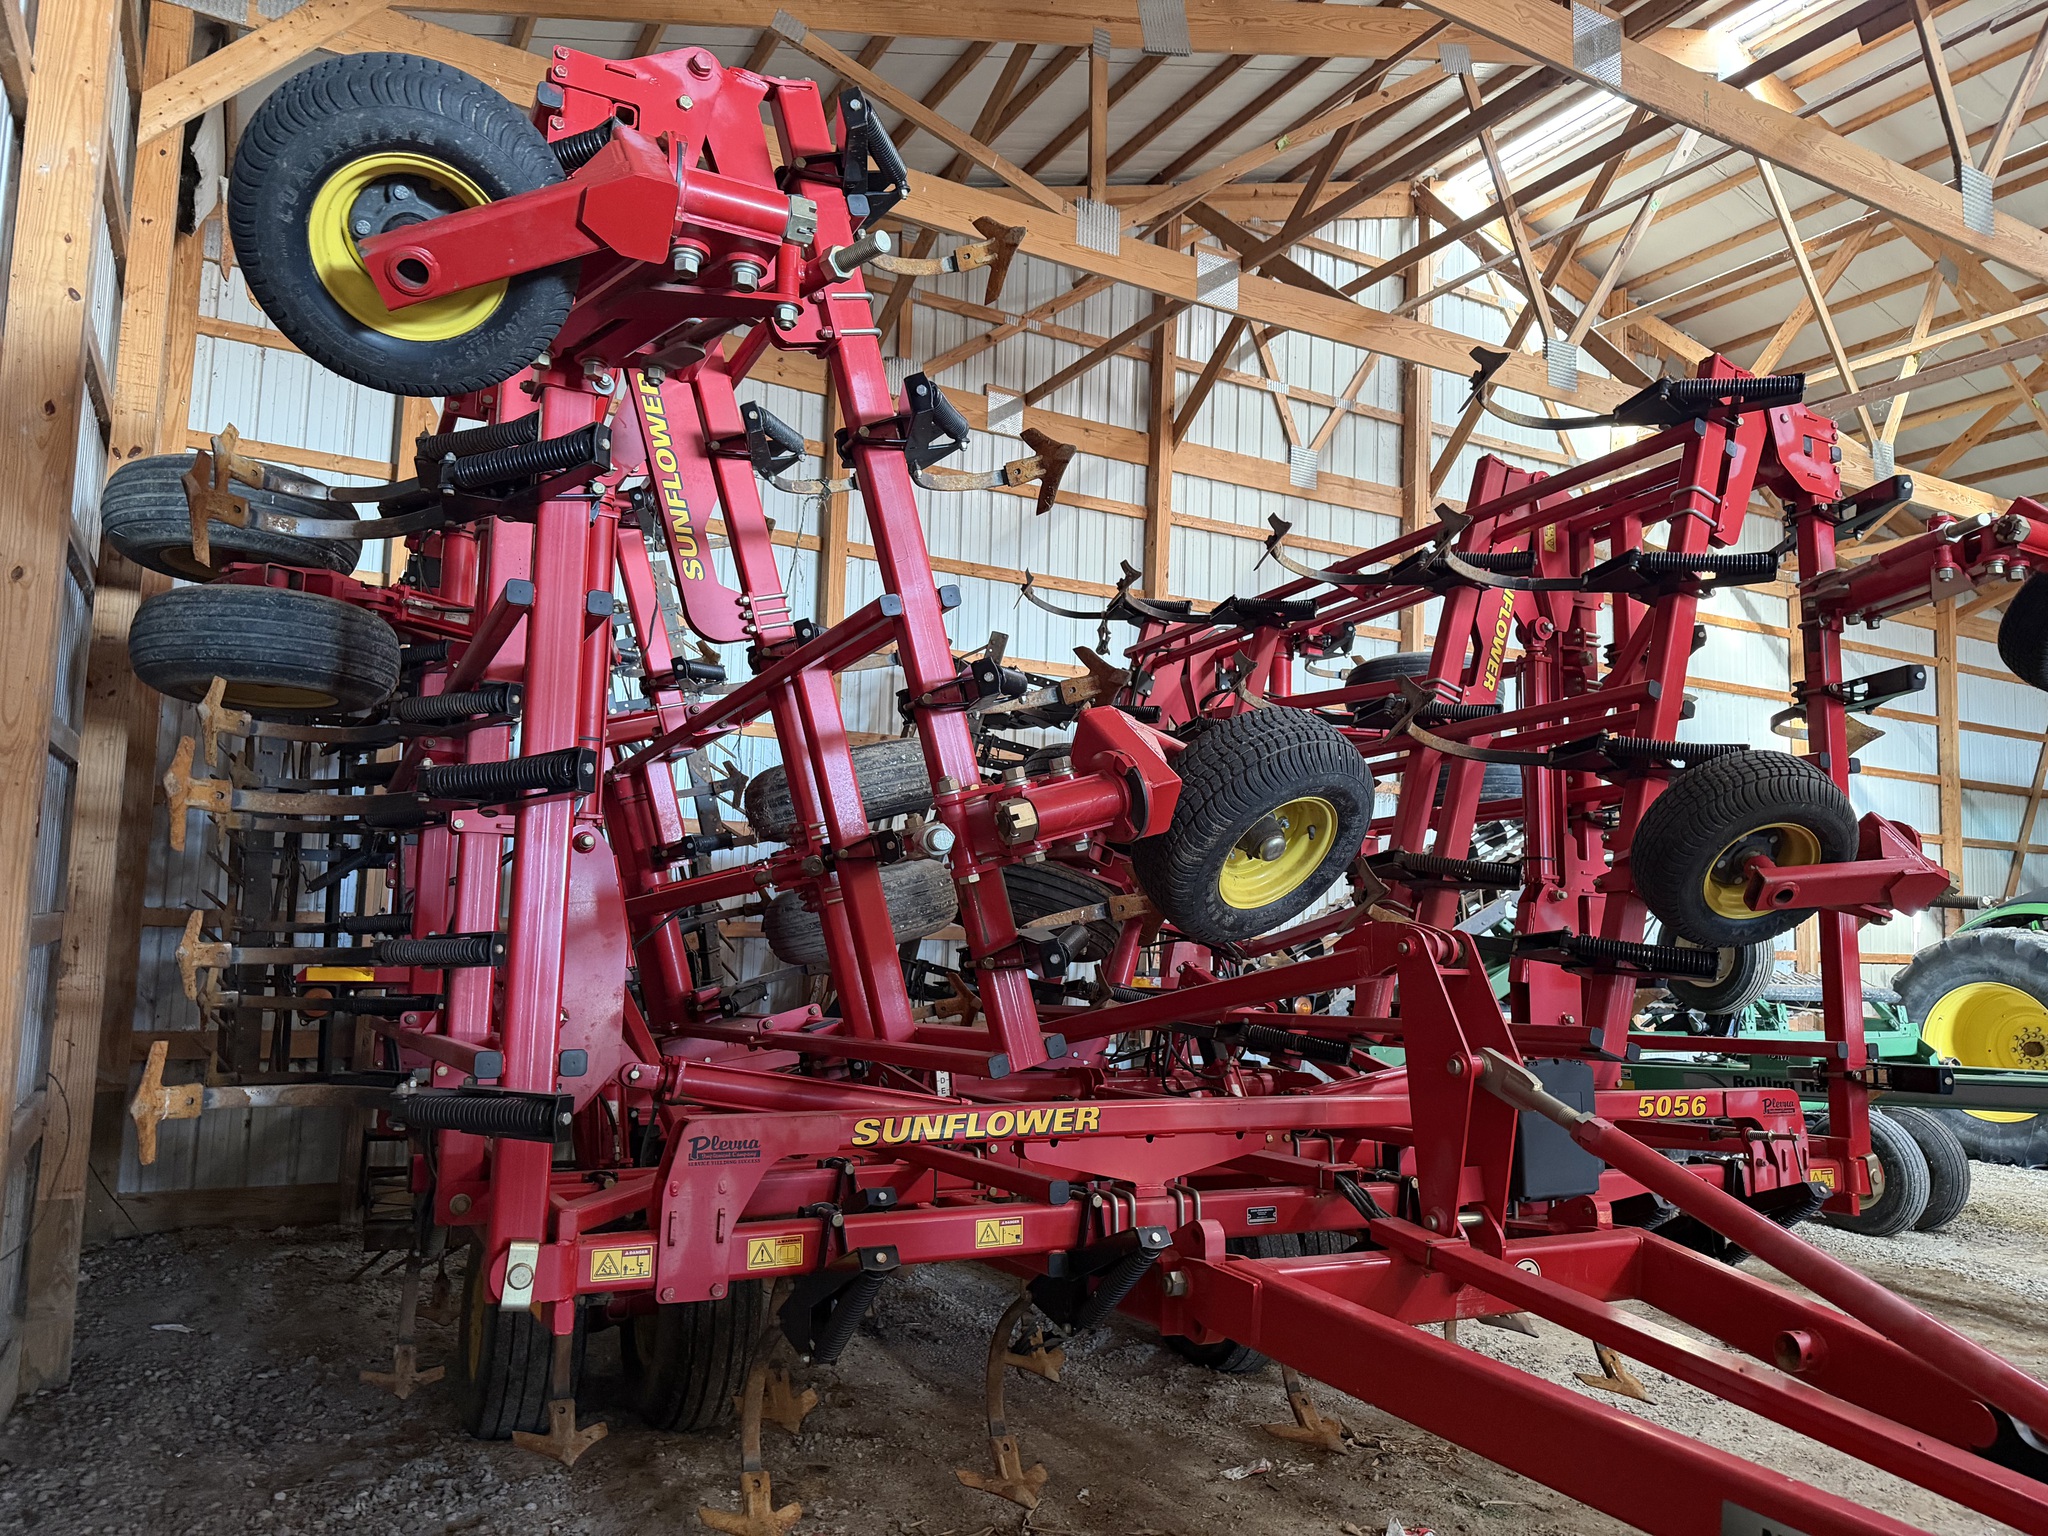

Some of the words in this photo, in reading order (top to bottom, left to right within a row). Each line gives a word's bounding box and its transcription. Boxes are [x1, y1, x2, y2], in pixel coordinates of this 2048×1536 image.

[636, 371, 705, 582] SUNFLOWER
[1638, 1095, 1707, 1118] 5056
[850, 1106, 1101, 1148] SUNFLOWER
[687, 1135, 761, 1159] Plevna
